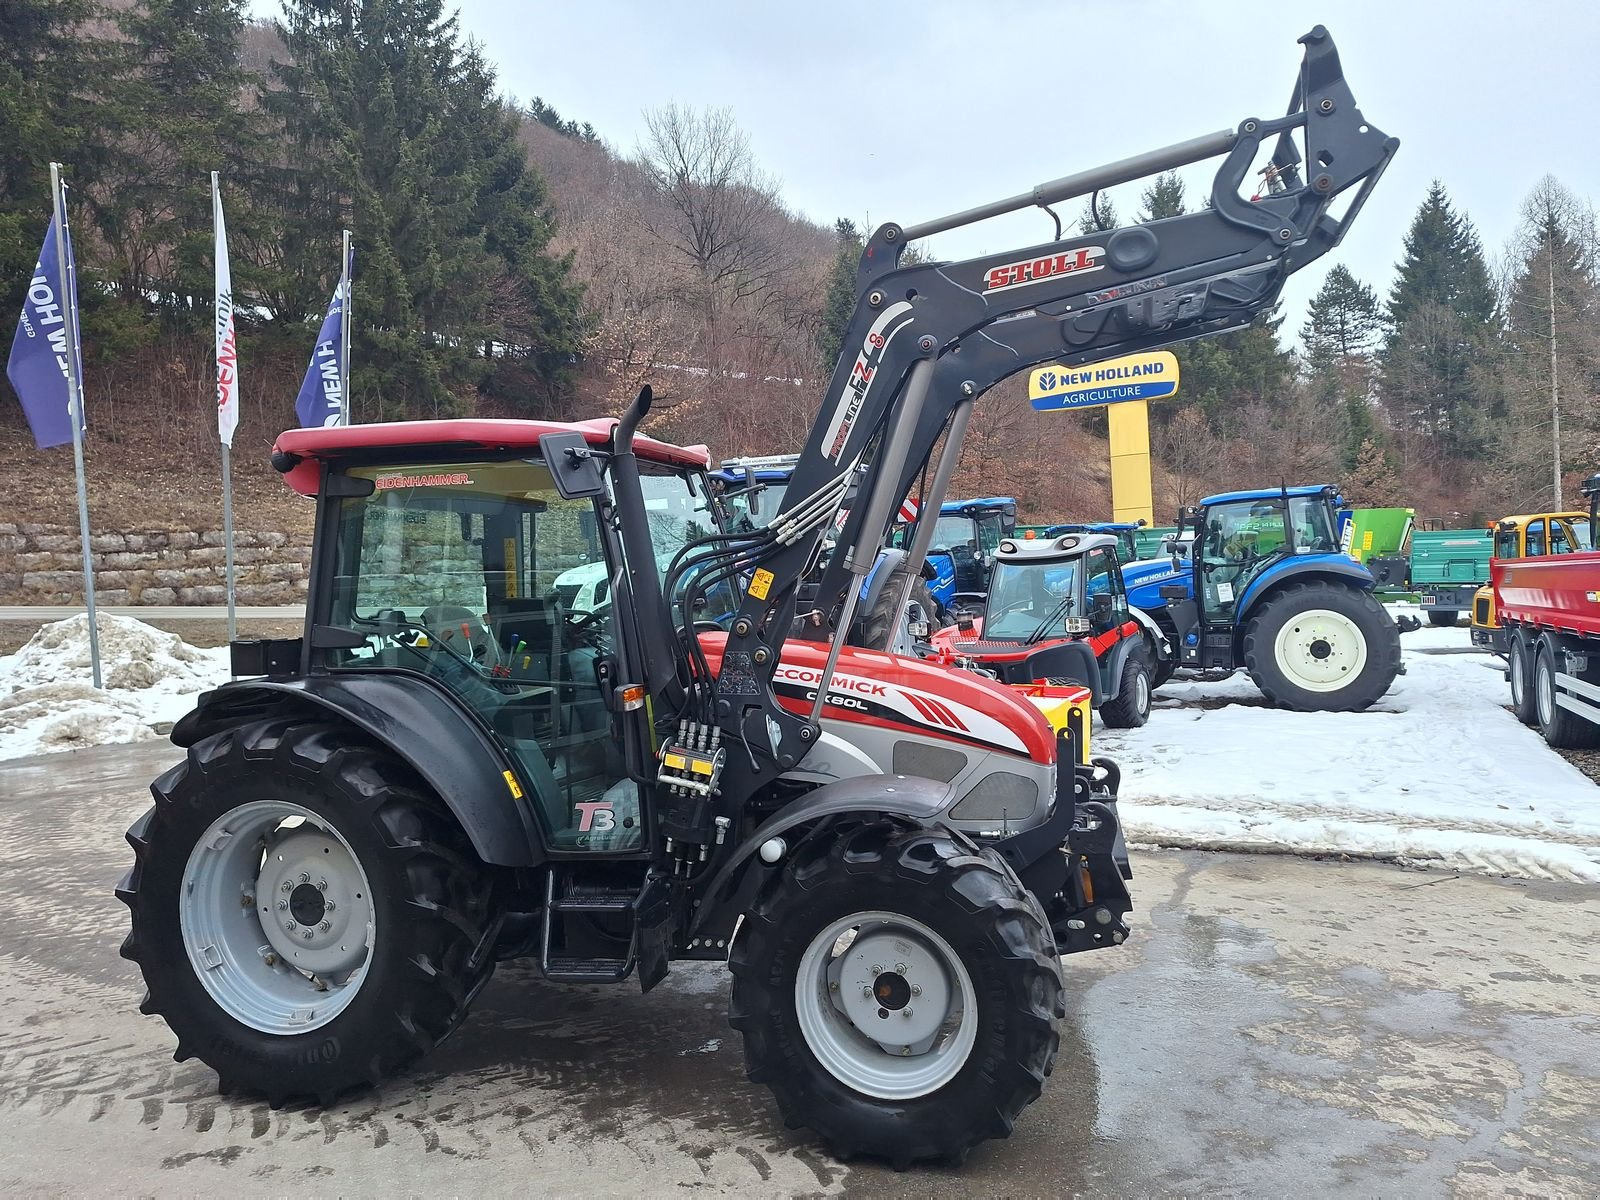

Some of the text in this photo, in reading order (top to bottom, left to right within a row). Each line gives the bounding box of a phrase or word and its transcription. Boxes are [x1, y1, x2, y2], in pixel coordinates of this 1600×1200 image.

[987, 249, 1095, 289] STOLL
[850, 361, 874, 396] FZ
[869, 332, 885, 349] 8
[1060, 362, 1164, 386] NEW HOLLAND
[1063, 386, 1141, 405] AGRICULTURE
[375, 473, 469, 490] EIDENHAMMER
[1134, 570, 1180, 585] NEW HOLLAN
[575, 801, 616, 832] T3
